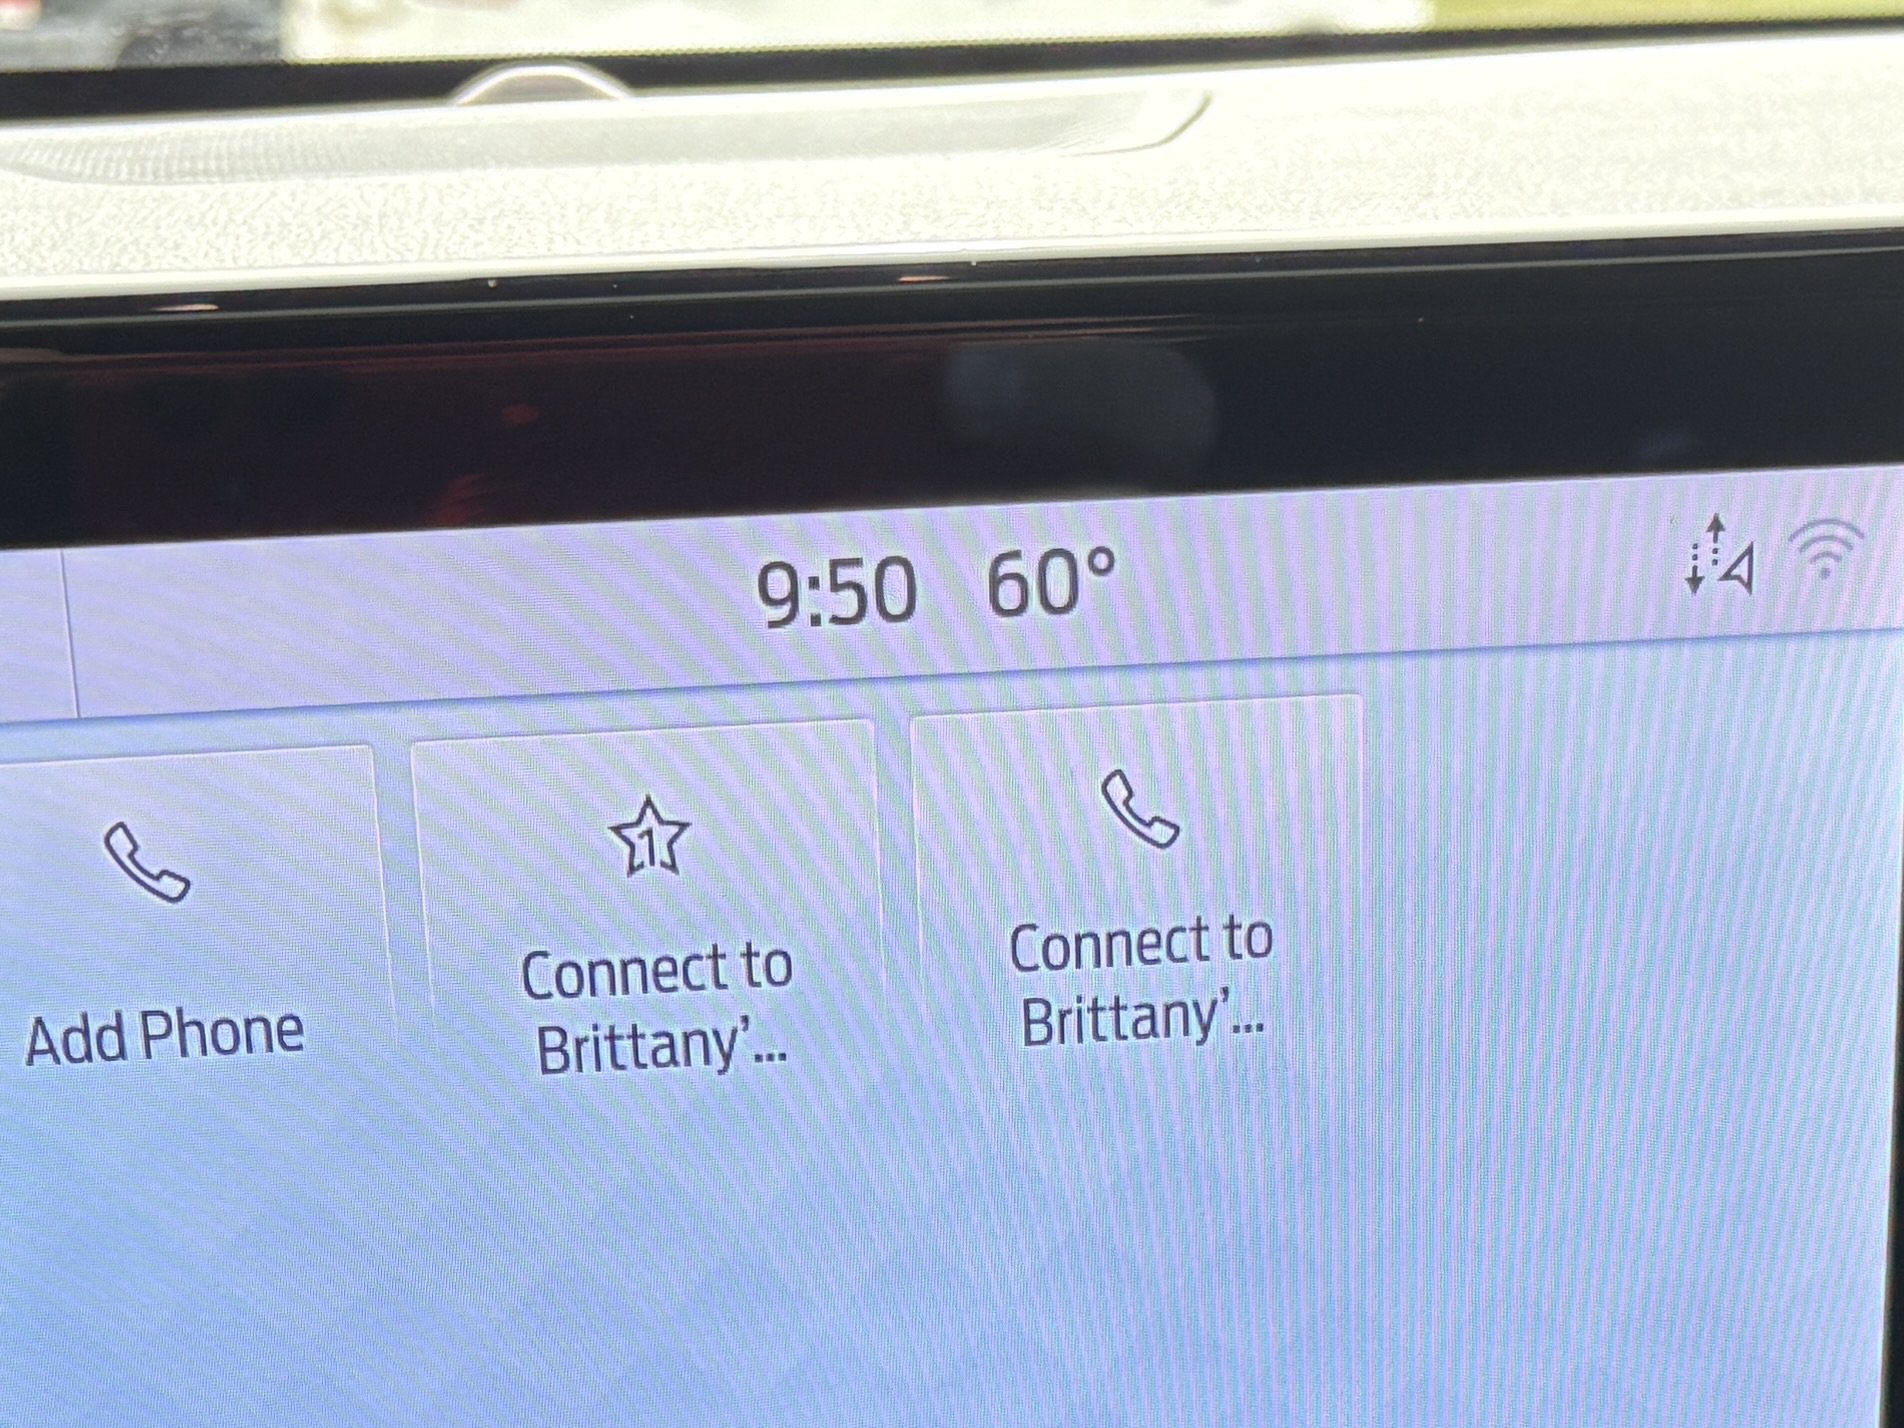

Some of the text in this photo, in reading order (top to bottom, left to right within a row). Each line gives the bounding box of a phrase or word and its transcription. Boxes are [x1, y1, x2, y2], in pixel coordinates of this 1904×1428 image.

[758, 545, 1117, 630] 9:50 60°
[637, 828, 657, 868] 1
[521, 940, 794, 1001] Connect to
[1010, 911, 1275, 974] Connect to
[25, 1005, 306, 1067] Add Phone
